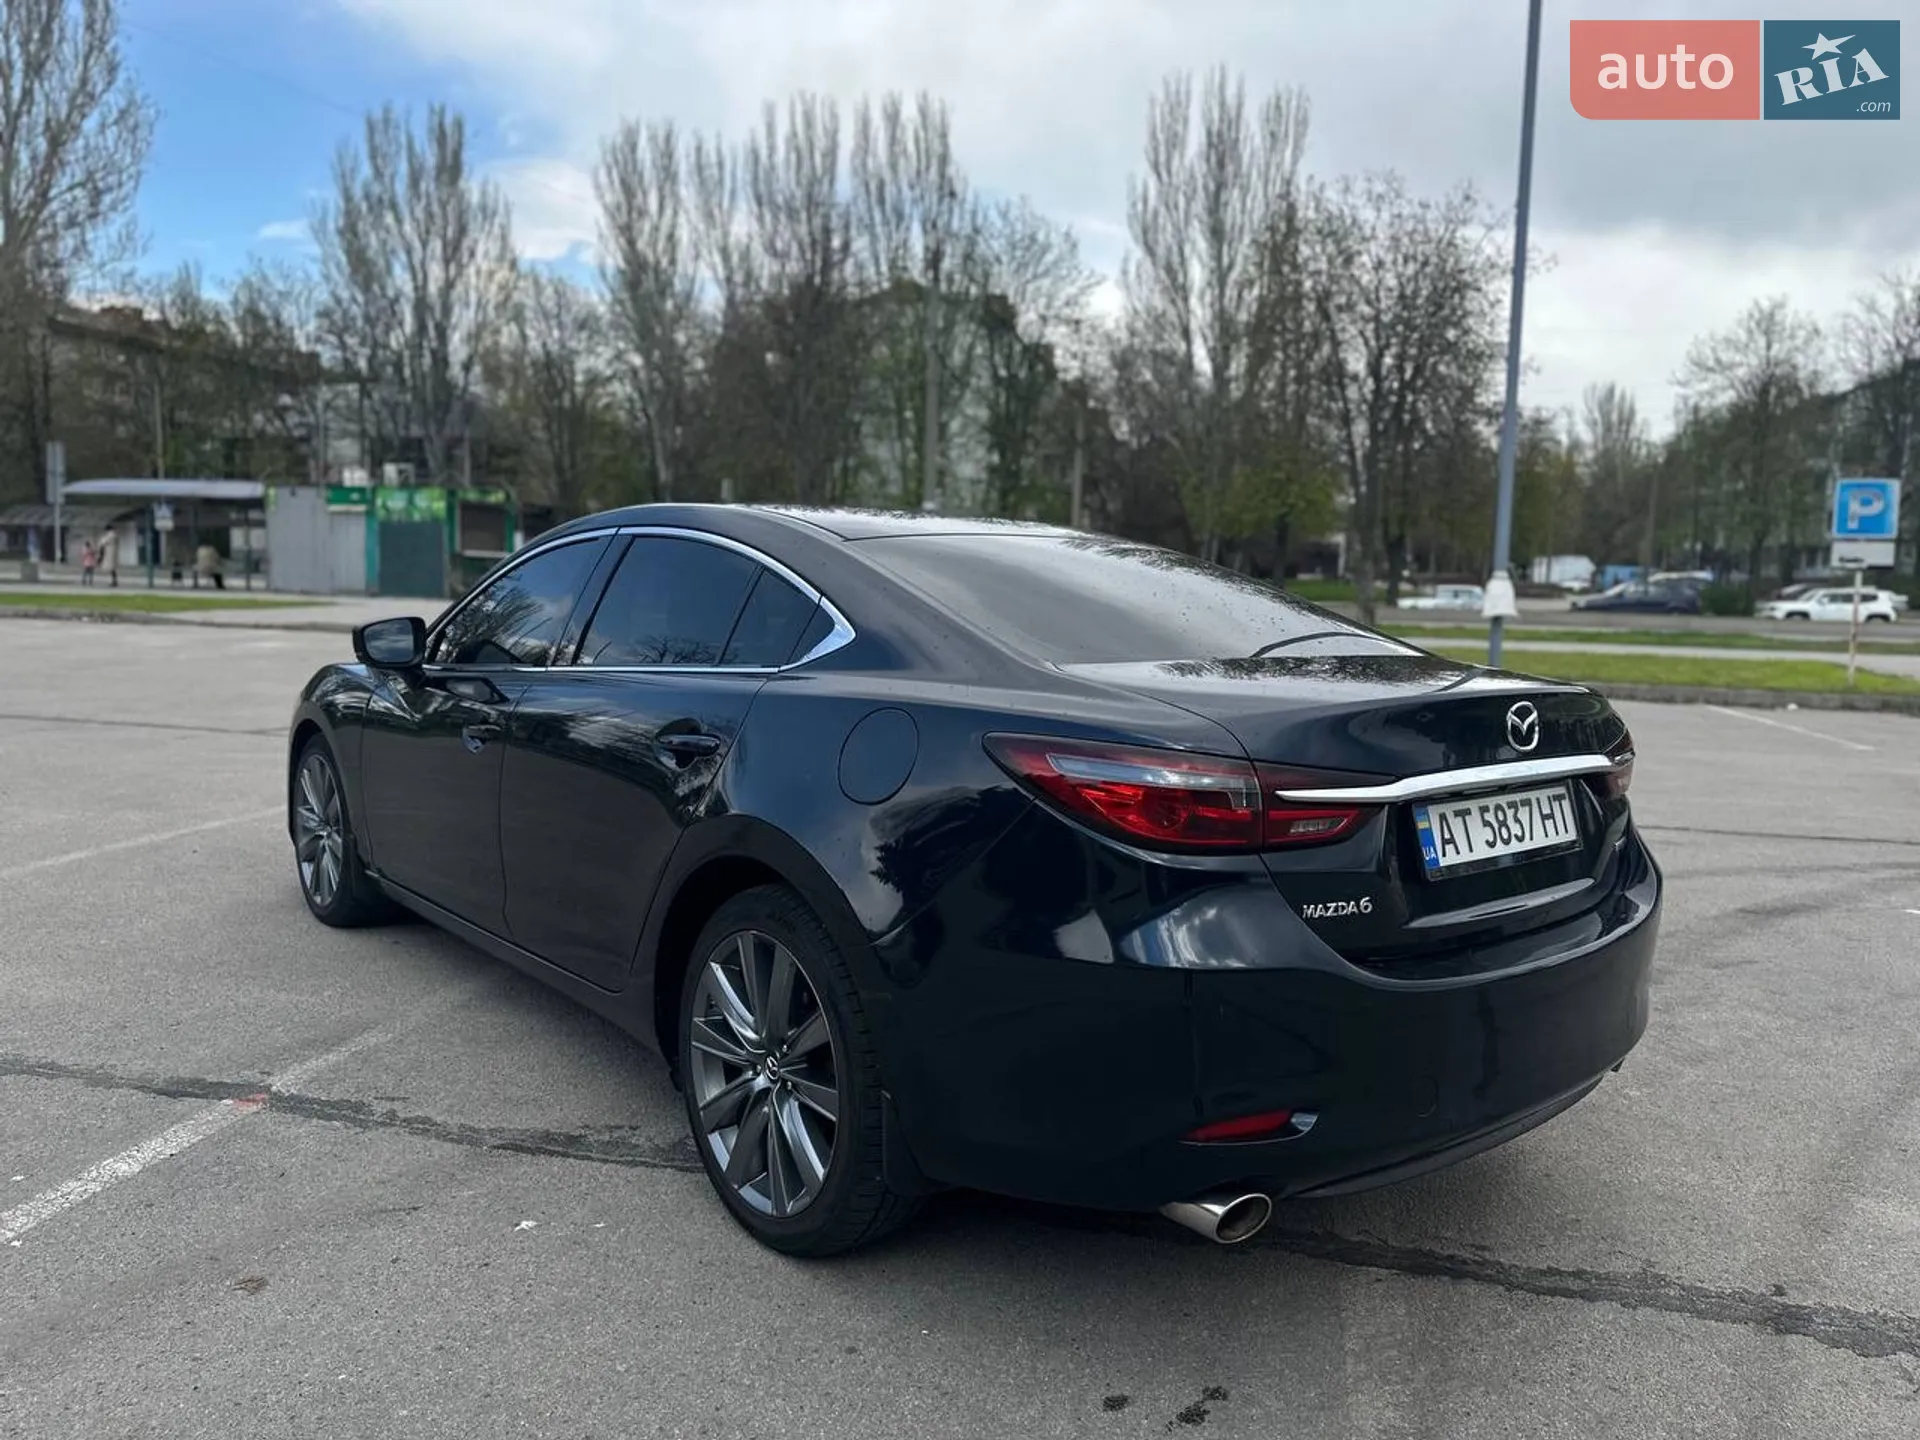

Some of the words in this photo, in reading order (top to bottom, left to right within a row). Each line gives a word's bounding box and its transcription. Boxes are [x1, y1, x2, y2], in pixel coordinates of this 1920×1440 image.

[1847, 487, 1885, 530] P
[1438, 807, 1474, 858] AT
[1478, 797, 1535, 849] 5837
[1536, 792, 1570, 838] HT
[1422, 845, 1437, 861] UA
